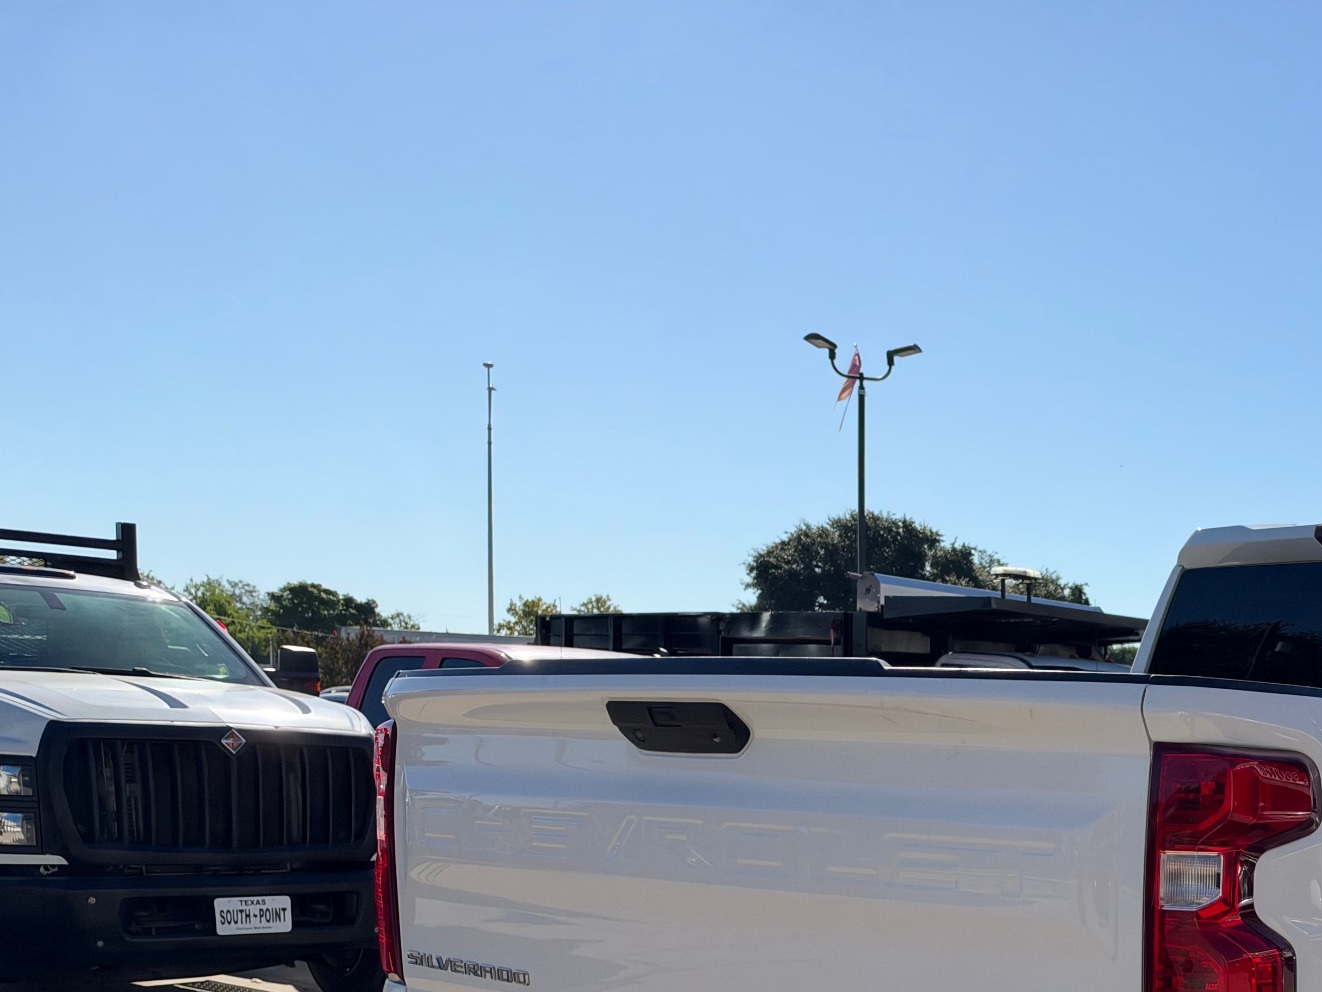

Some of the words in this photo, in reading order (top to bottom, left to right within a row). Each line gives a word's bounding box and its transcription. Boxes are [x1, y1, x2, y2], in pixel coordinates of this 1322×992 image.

[238, 898, 267, 906] TEXAS
[219, 908, 252, 925] SOUTH
[258, 907, 287, 923] POINT
[407, 950, 531, 986] SILVERADO
